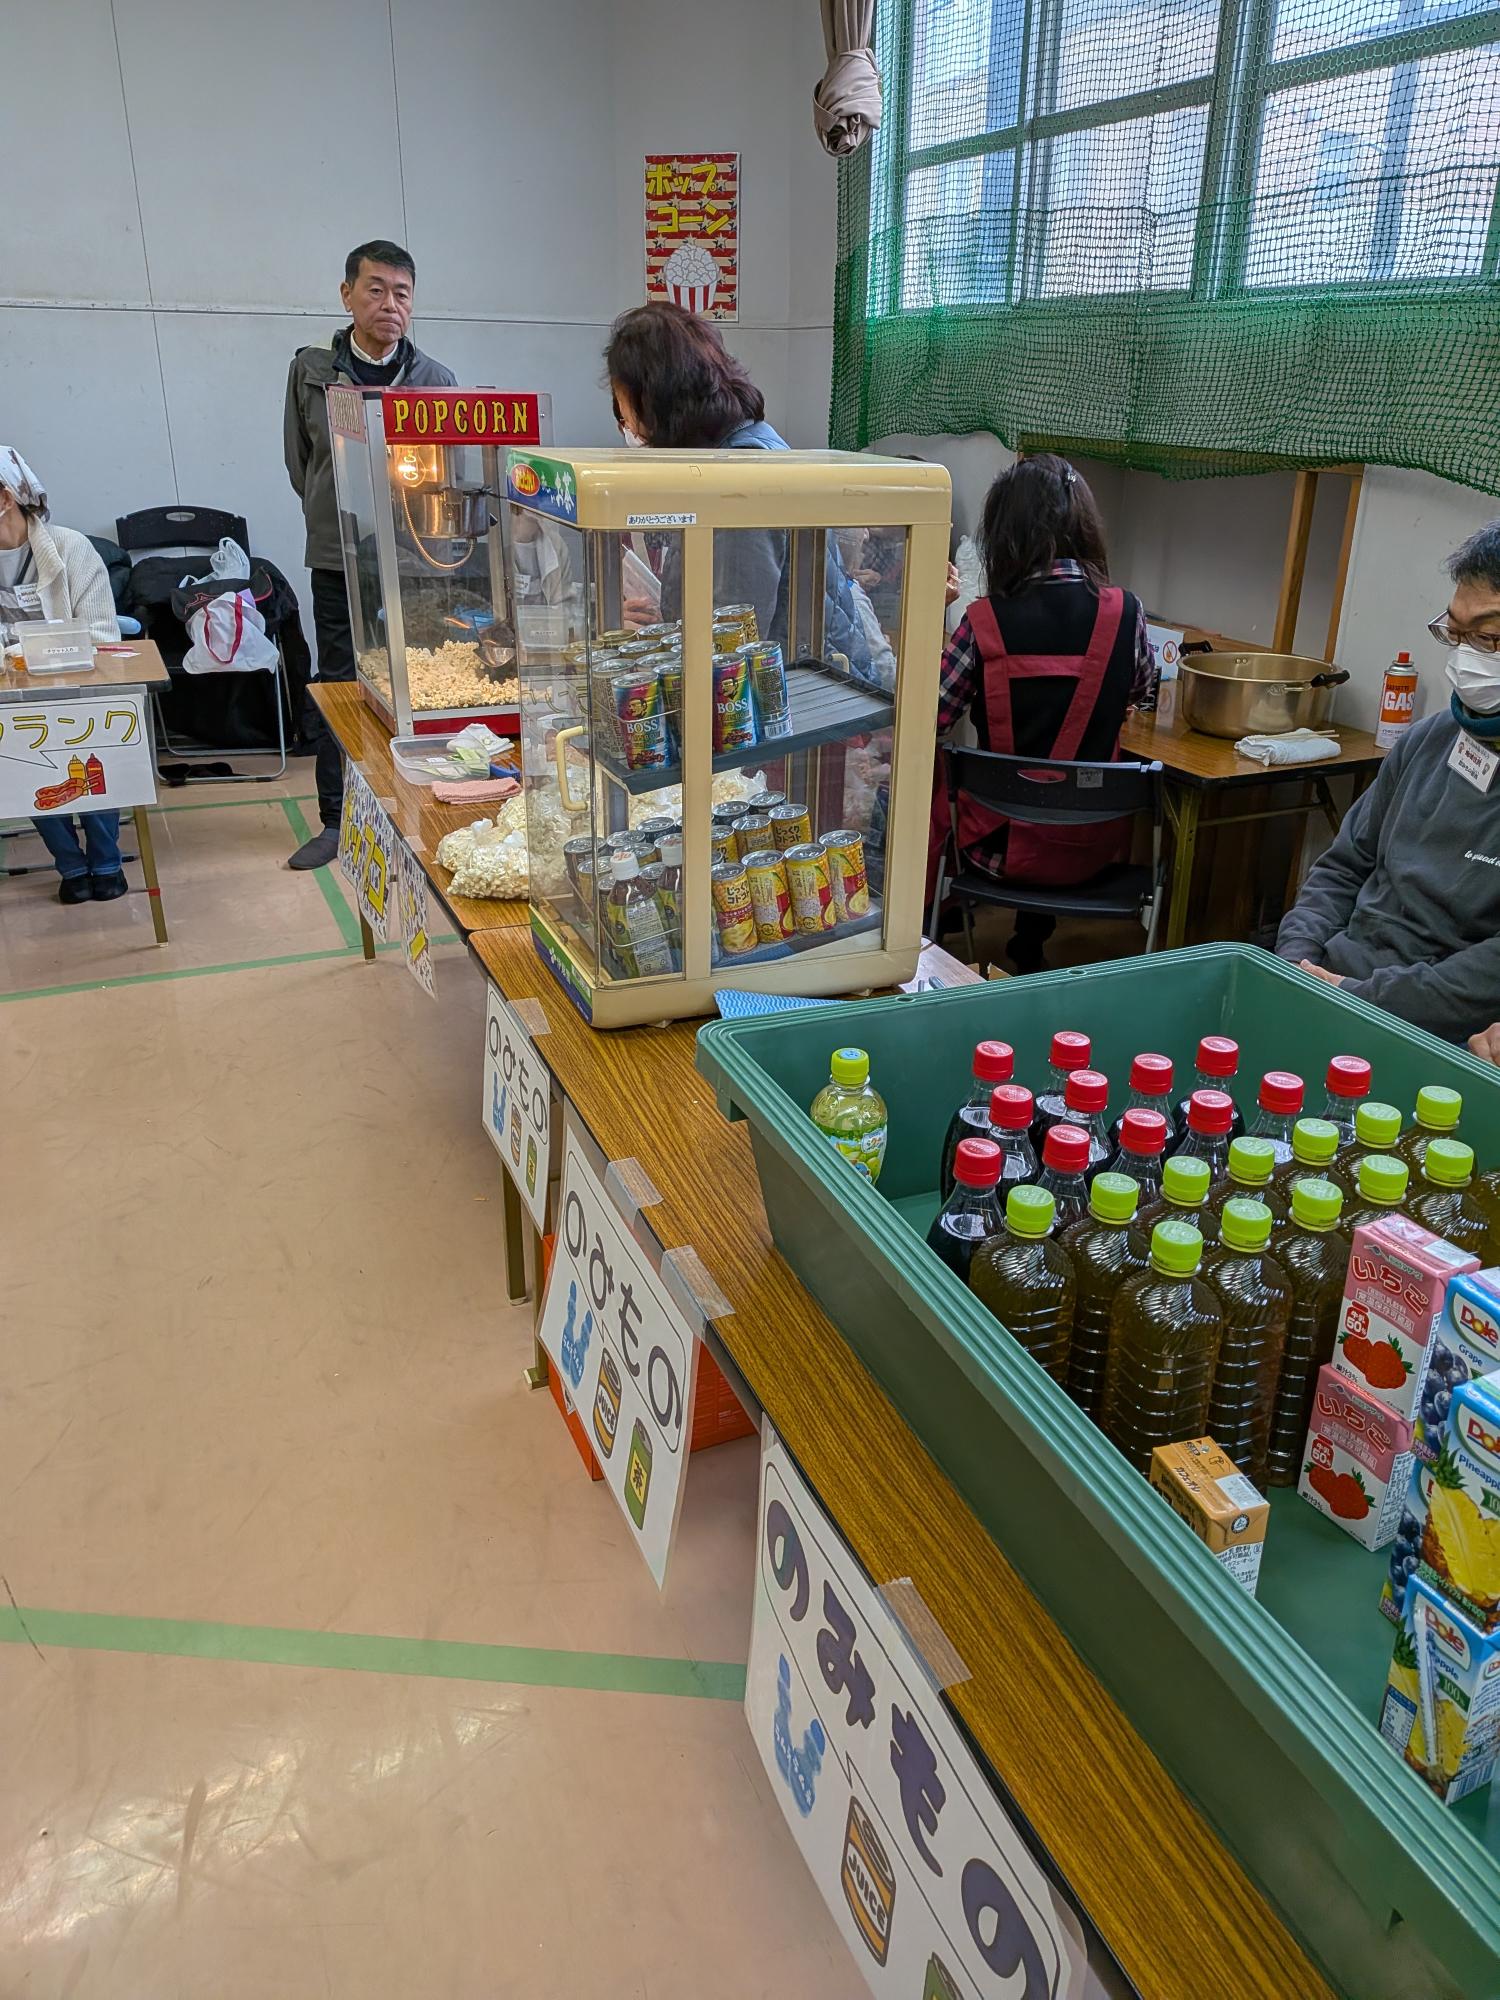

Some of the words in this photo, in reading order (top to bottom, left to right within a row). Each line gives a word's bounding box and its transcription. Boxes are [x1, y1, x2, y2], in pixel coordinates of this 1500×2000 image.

[646, 163, 717, 195] ポップ
[657, 202, 730, 235] コーン
[393, 399, 528, 434] POPCORN
[628, 513, 695, 524] ありがとうございます
[717, 697, 748, 713] BOSS
[1384, 690, 1416, 711] GAS
[0, 711, 137, 749] ランク
[627, 719, 658, 733] BOSS
[489, 1015, 547, 1132] のみもの
[1352, 1255, 1428, 1316] いちご
[565, 1190, 682, 1430] のみもの
[1461, 1304, 1499, 1344] Dole
[1458, 1343, 1483, 1367] Grape
[598, 1391, 617, 1433] JUICE
[1317, 1392, 1391, 1454] いちご
[1425, 1604, 1465, 1652] Dole
[767, 1500, 1050, 2000] のみもの
[848, 1853, 888, 1932] JUICE
